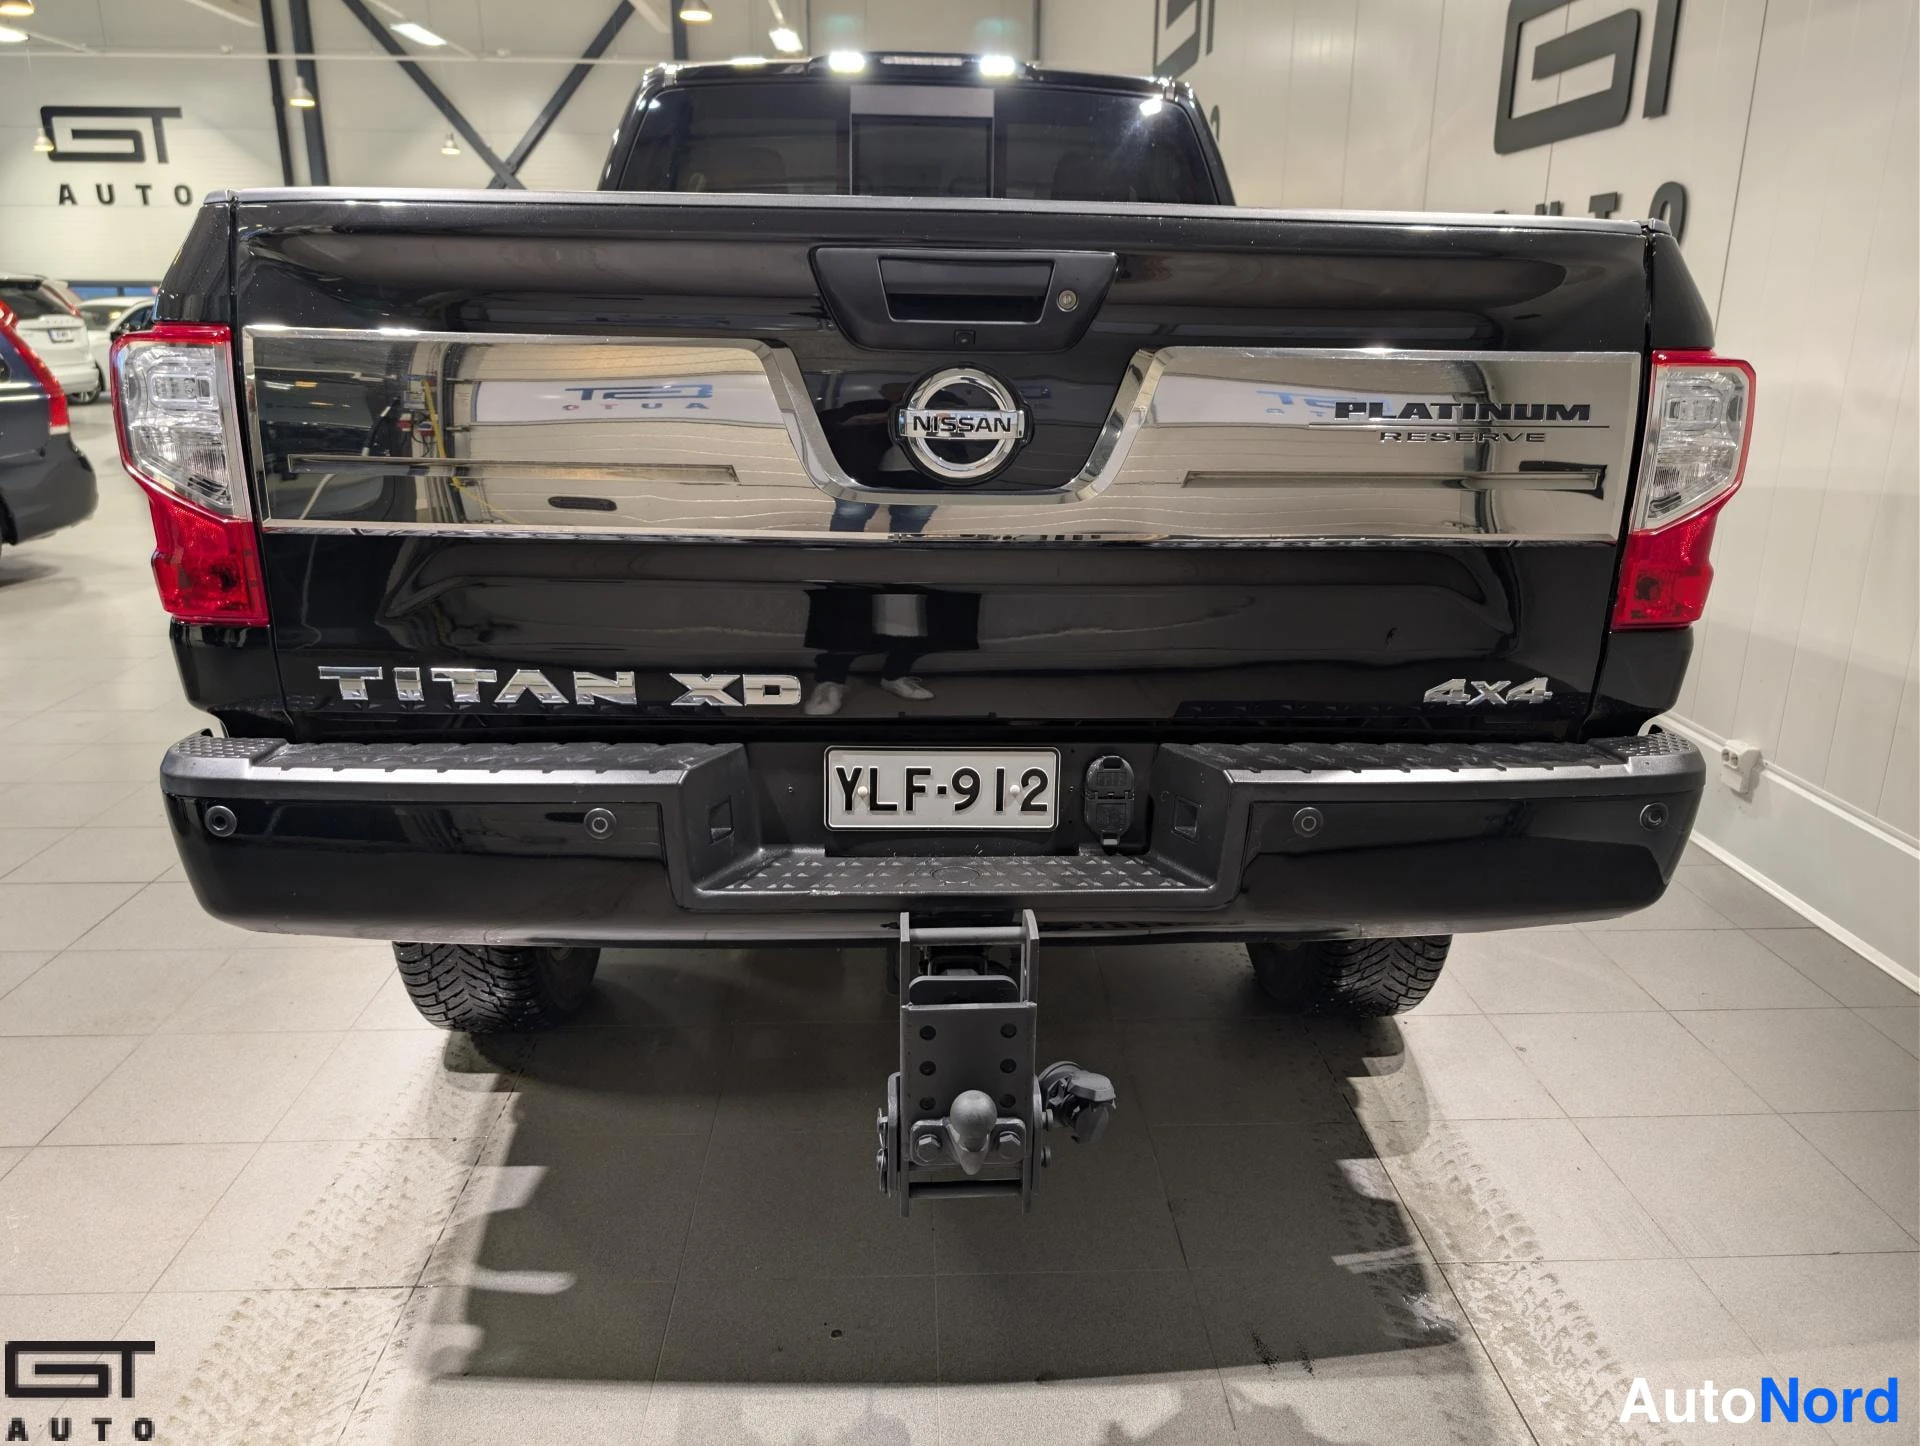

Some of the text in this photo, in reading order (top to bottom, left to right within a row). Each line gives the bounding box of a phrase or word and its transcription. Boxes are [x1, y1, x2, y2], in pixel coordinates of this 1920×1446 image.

[40, 105, 183, 164] GT
[58, 183, 194, 207] AUTO
[913, 415, 1012, 433] NISSAN
[1333, 401, 1592, 424] PLATINUM
[1378, 430, 1548, 444] RESERVE
[318, 666, 801, 706] TITAN XD
[835, 765, 1049, 812] YLF-912
